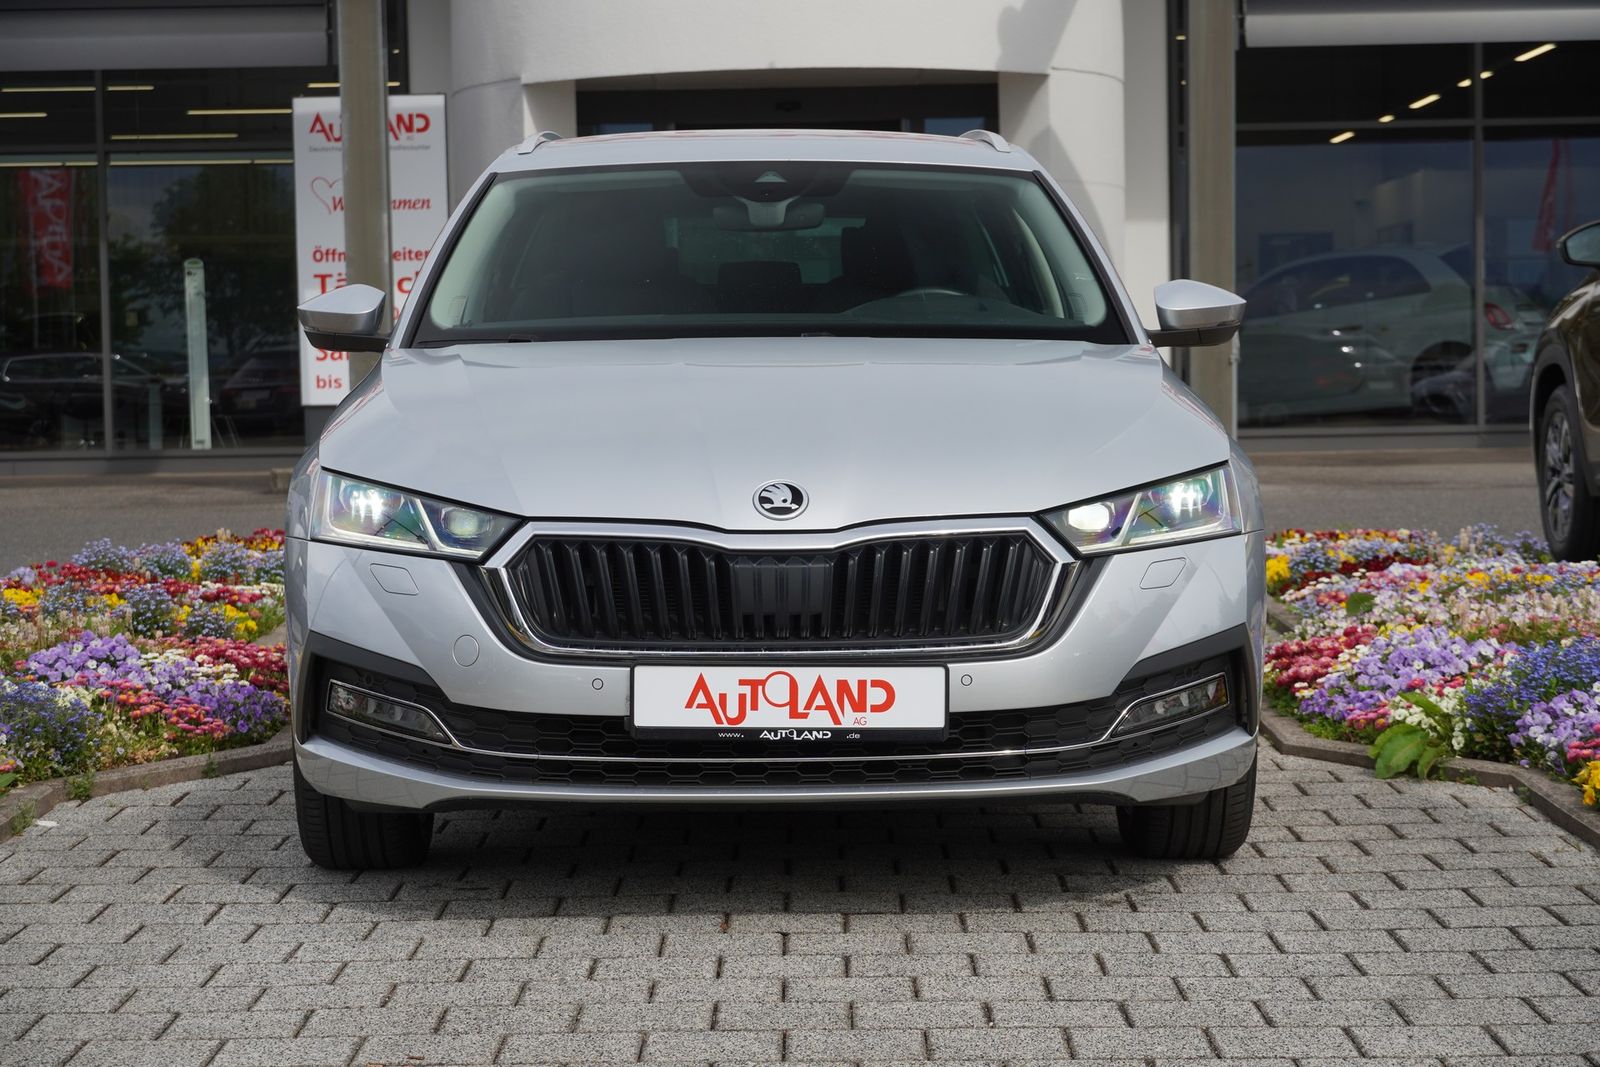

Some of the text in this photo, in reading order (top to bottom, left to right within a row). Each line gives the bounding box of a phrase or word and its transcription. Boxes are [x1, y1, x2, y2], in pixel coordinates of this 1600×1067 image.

[316, 375, 342, 389] bis
[684, 670, 896, 726] AUTOLAND
[852, 715, 868, 727] AG
[718, 728, 861, 741] www. AUTOLAND .de
